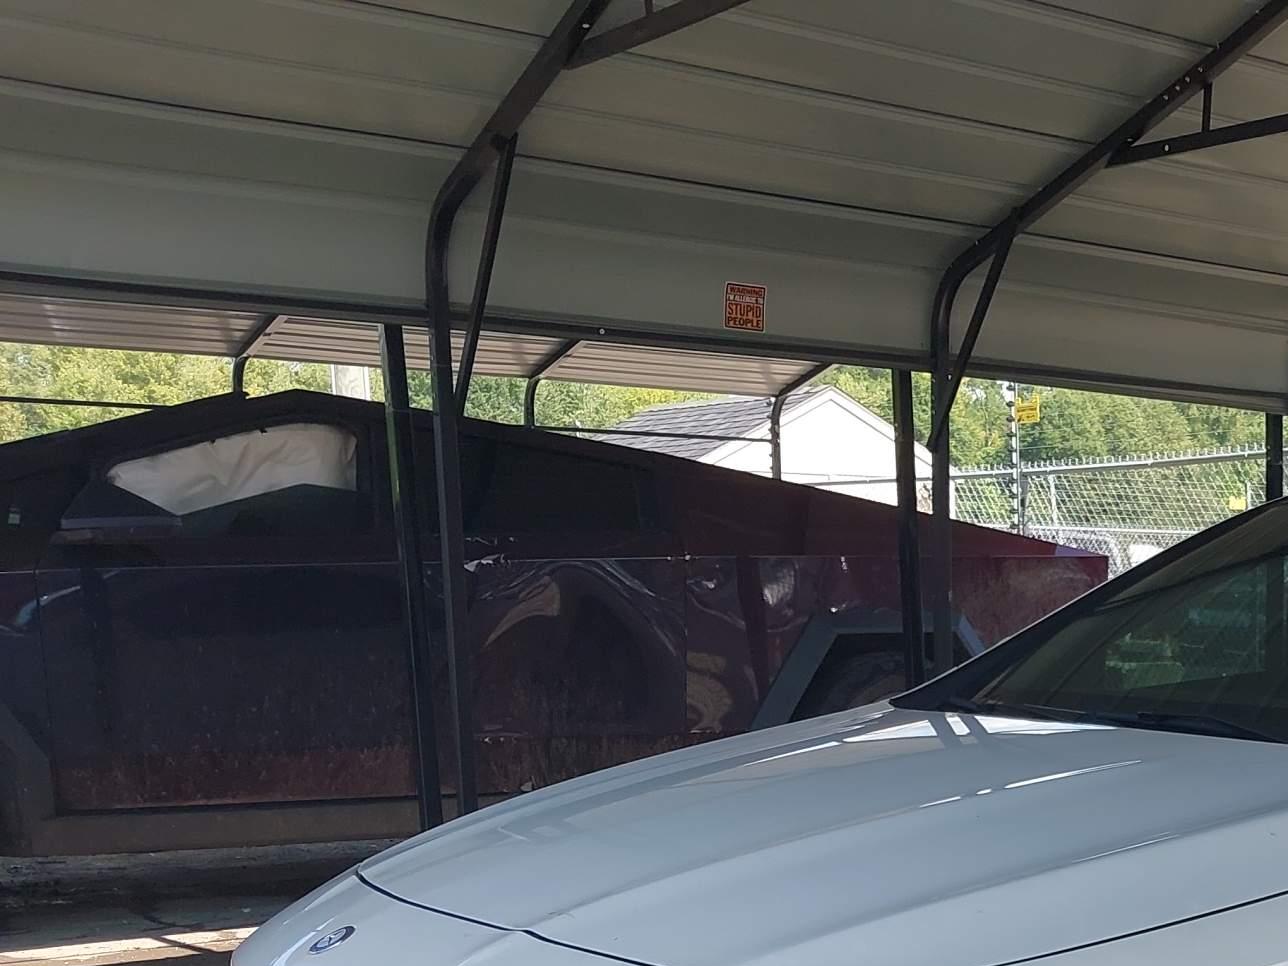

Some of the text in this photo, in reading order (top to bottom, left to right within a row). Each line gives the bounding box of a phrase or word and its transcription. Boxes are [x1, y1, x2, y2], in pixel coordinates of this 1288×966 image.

[729, 286, 763, 297] WARNING
[728, 302, 762, 319] STUPID
[727, 316, 762, 328] PEOPLE
